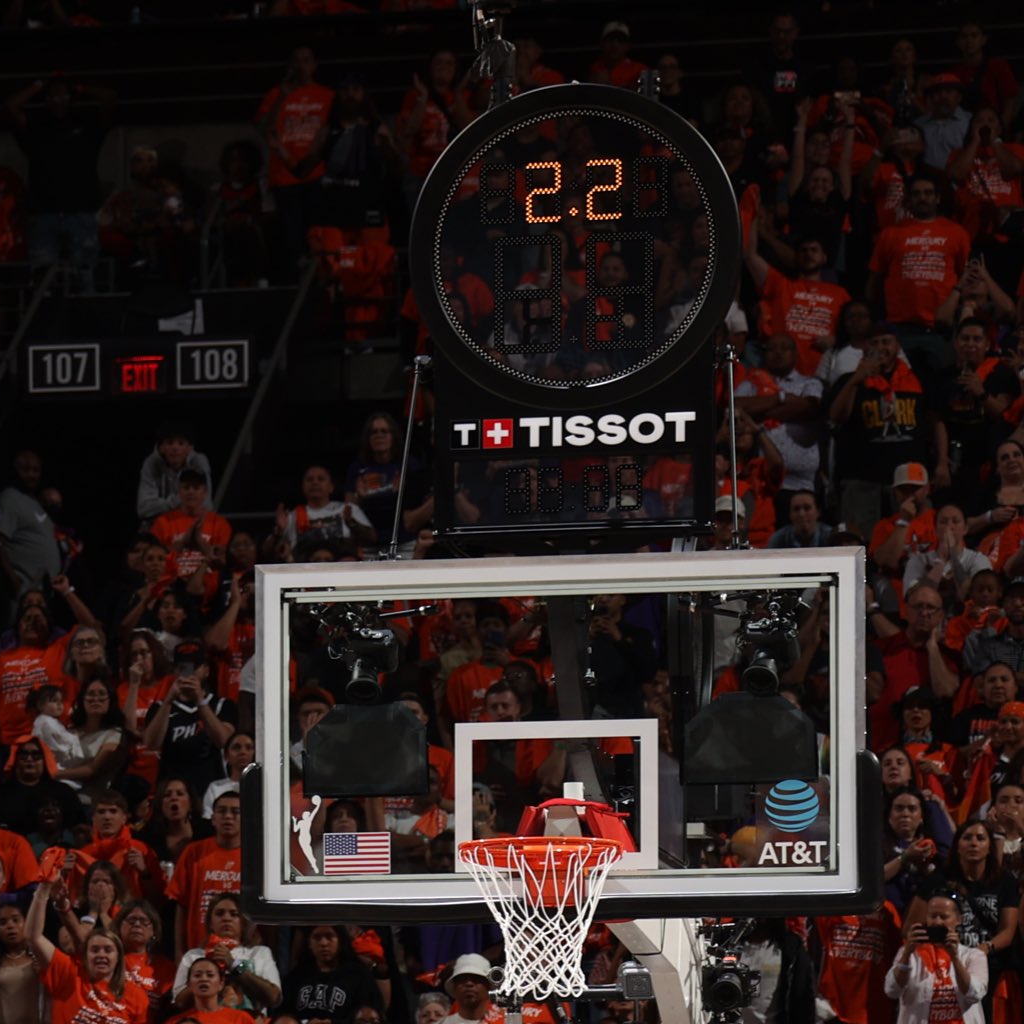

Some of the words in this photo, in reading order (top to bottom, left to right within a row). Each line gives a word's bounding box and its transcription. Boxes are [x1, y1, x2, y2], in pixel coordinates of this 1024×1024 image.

[526, 158, 622, 224] 2.2
[43, 353, 88, 385] 107
[121, 363, 159, 393] EXIT
[190, 349, 238, 381] 108
[453, 423, 476, 446] T
[519, 411, 696, 448] TISSOT
[758, 840, 827, 865] AT&T
[205, 870, 241, 882] MERCU
[296, 984, 347, 1013] GAP
